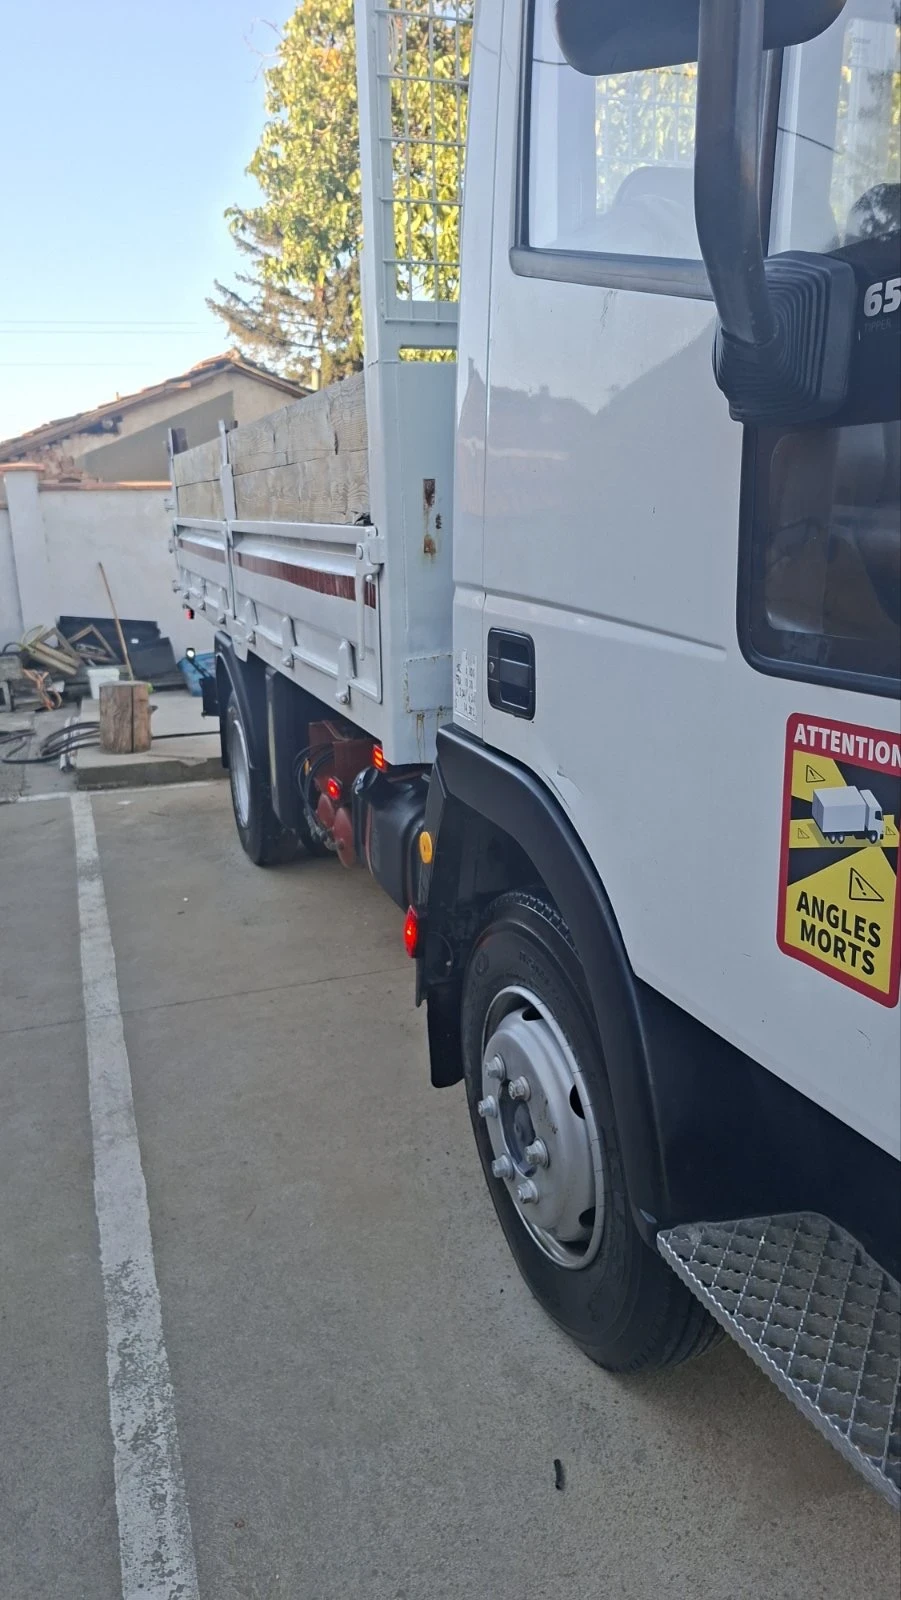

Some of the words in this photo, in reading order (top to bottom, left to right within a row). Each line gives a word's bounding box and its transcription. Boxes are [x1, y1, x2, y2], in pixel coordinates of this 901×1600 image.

[863, 277, 901, 317] 65
[796, 891, 881, 948] ANGLES
[800, 919, 875, 976] MORTS
